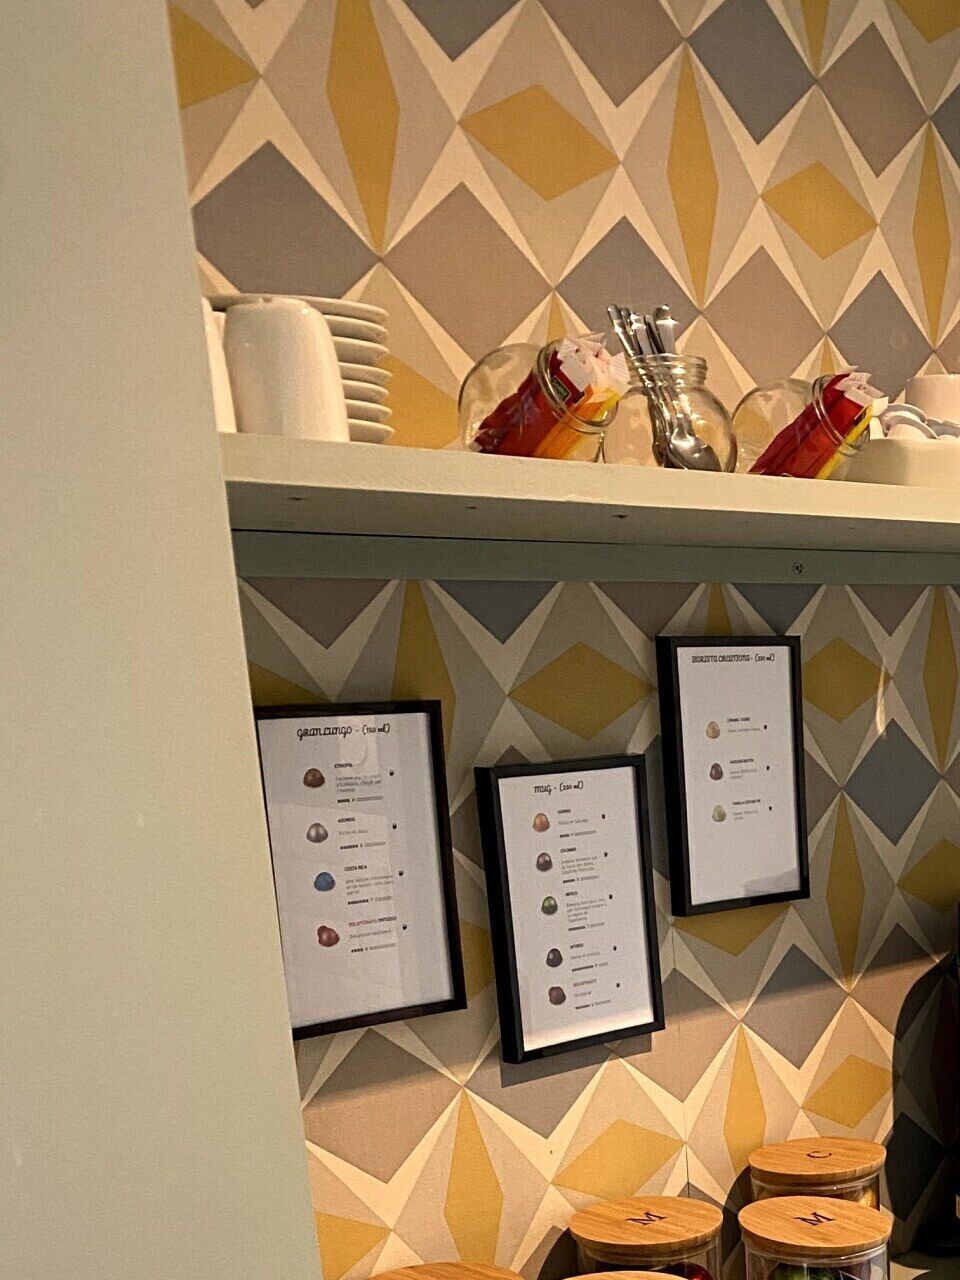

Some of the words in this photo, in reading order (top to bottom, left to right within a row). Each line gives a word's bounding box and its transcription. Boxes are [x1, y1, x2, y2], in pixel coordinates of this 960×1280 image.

[806, 1150, 832, 1159] C
[625, 1210, 668, 1226] M
[793, 1211, 835, 1227] M
